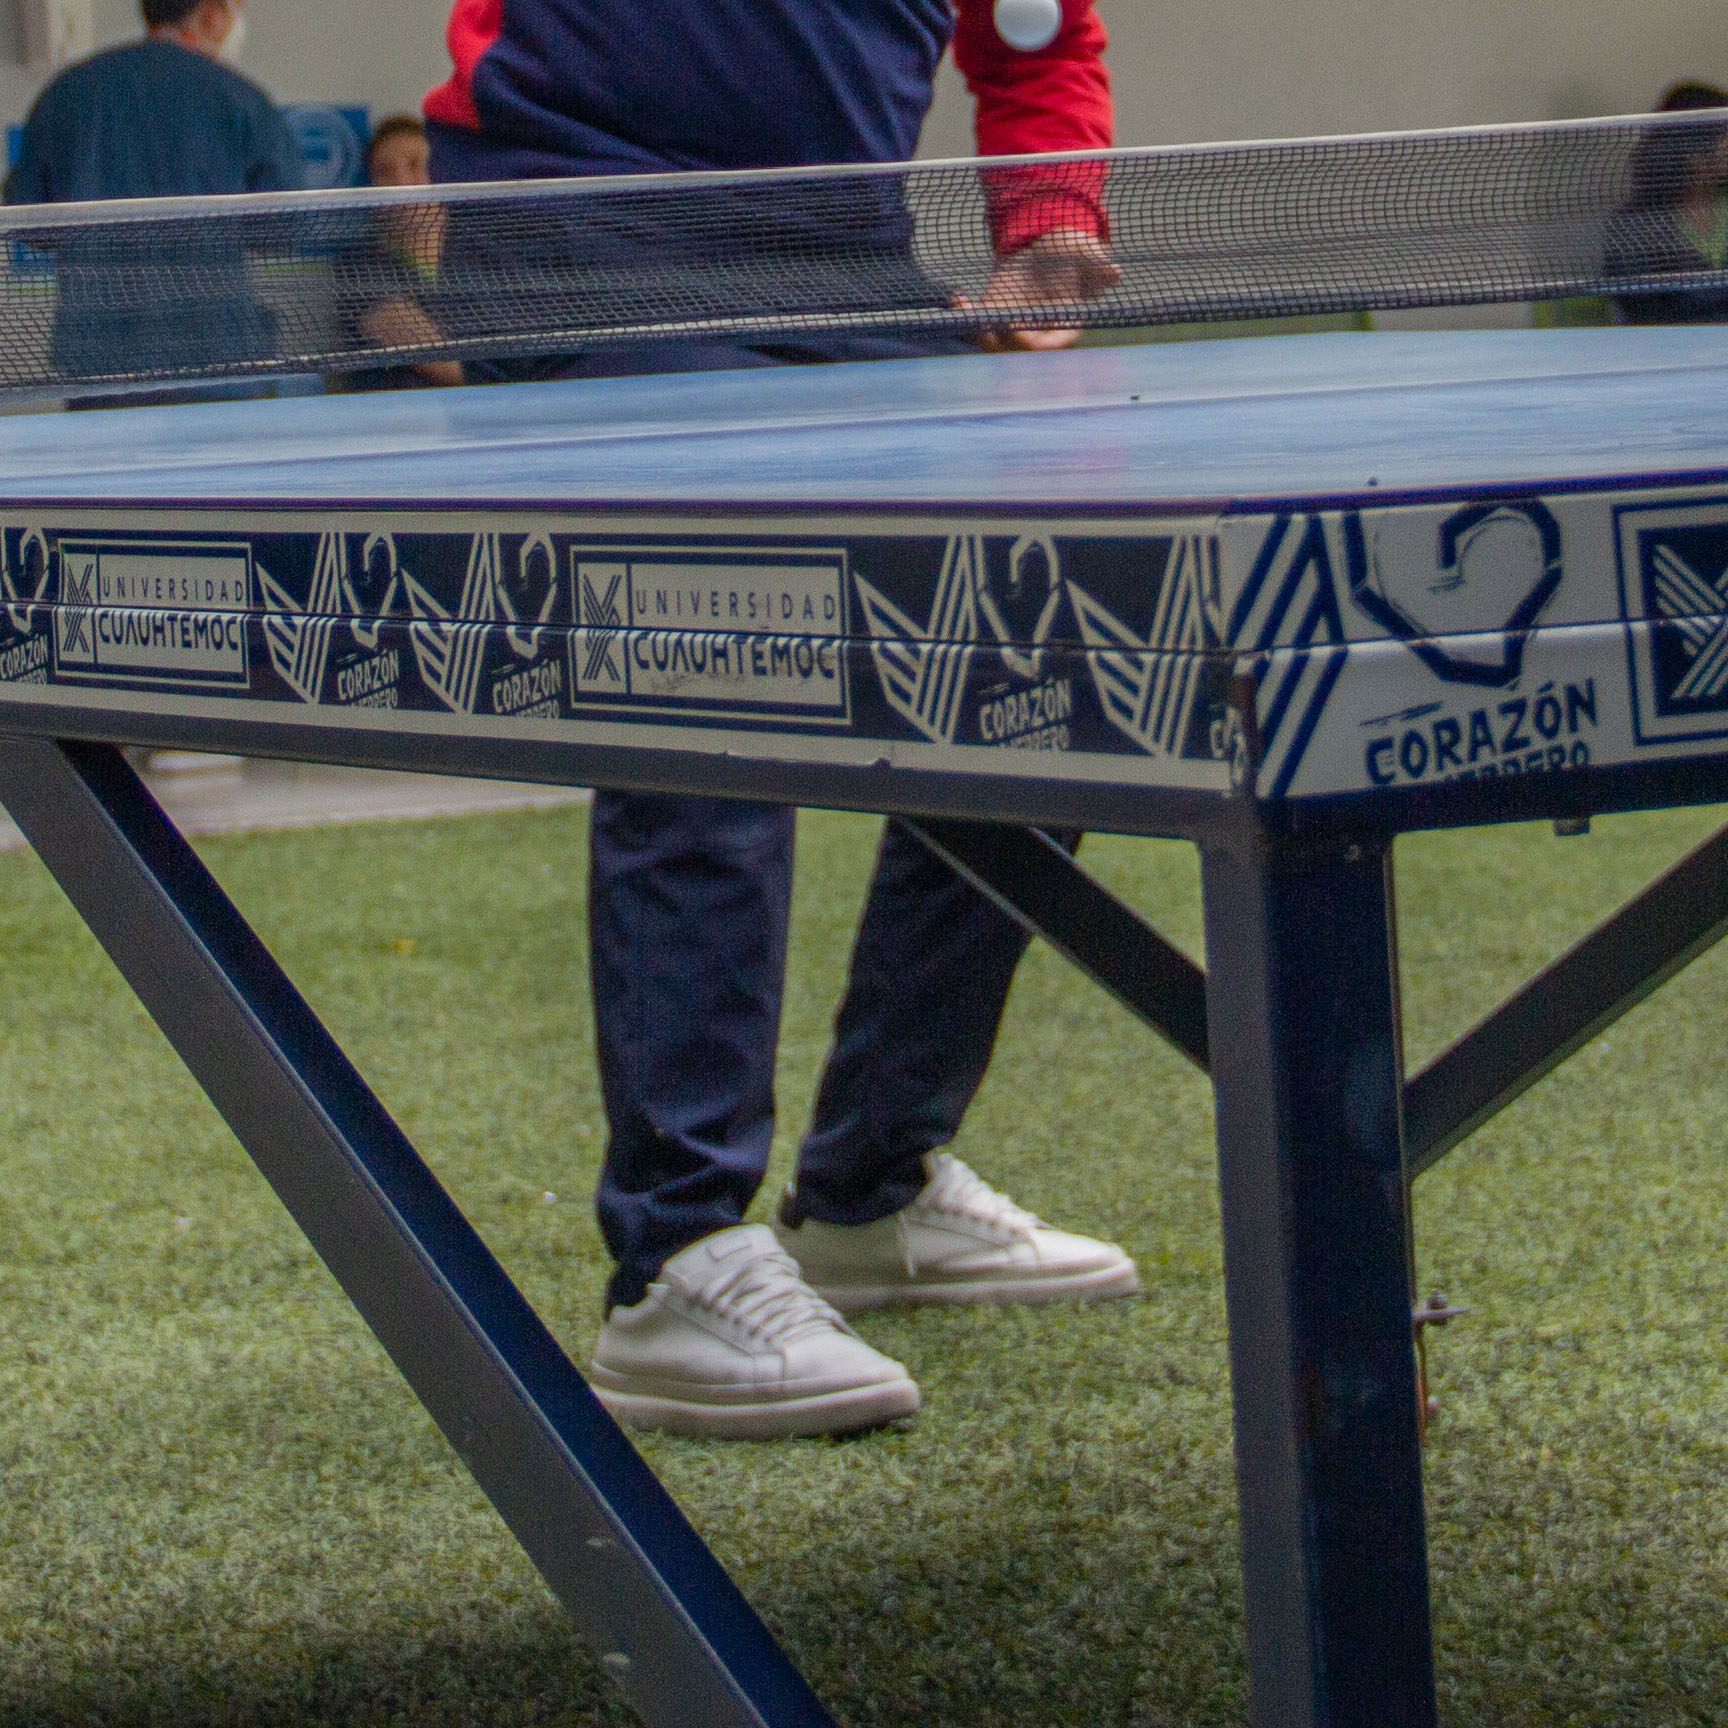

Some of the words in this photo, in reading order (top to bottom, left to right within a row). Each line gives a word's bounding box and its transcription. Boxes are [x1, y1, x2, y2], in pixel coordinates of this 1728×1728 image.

[102, 576, 244, 602] UNIVERSIDAD
[636, 589, 836, 621] UNIVERSIDAD
[337, 648, 400, 700] CORAZÓN
[493, 658, 561, 713] CORAZÓN
[979, 678, 1072, 740] CORAZÓN
[1365, 677, 1597, 785] CORAZÓN
